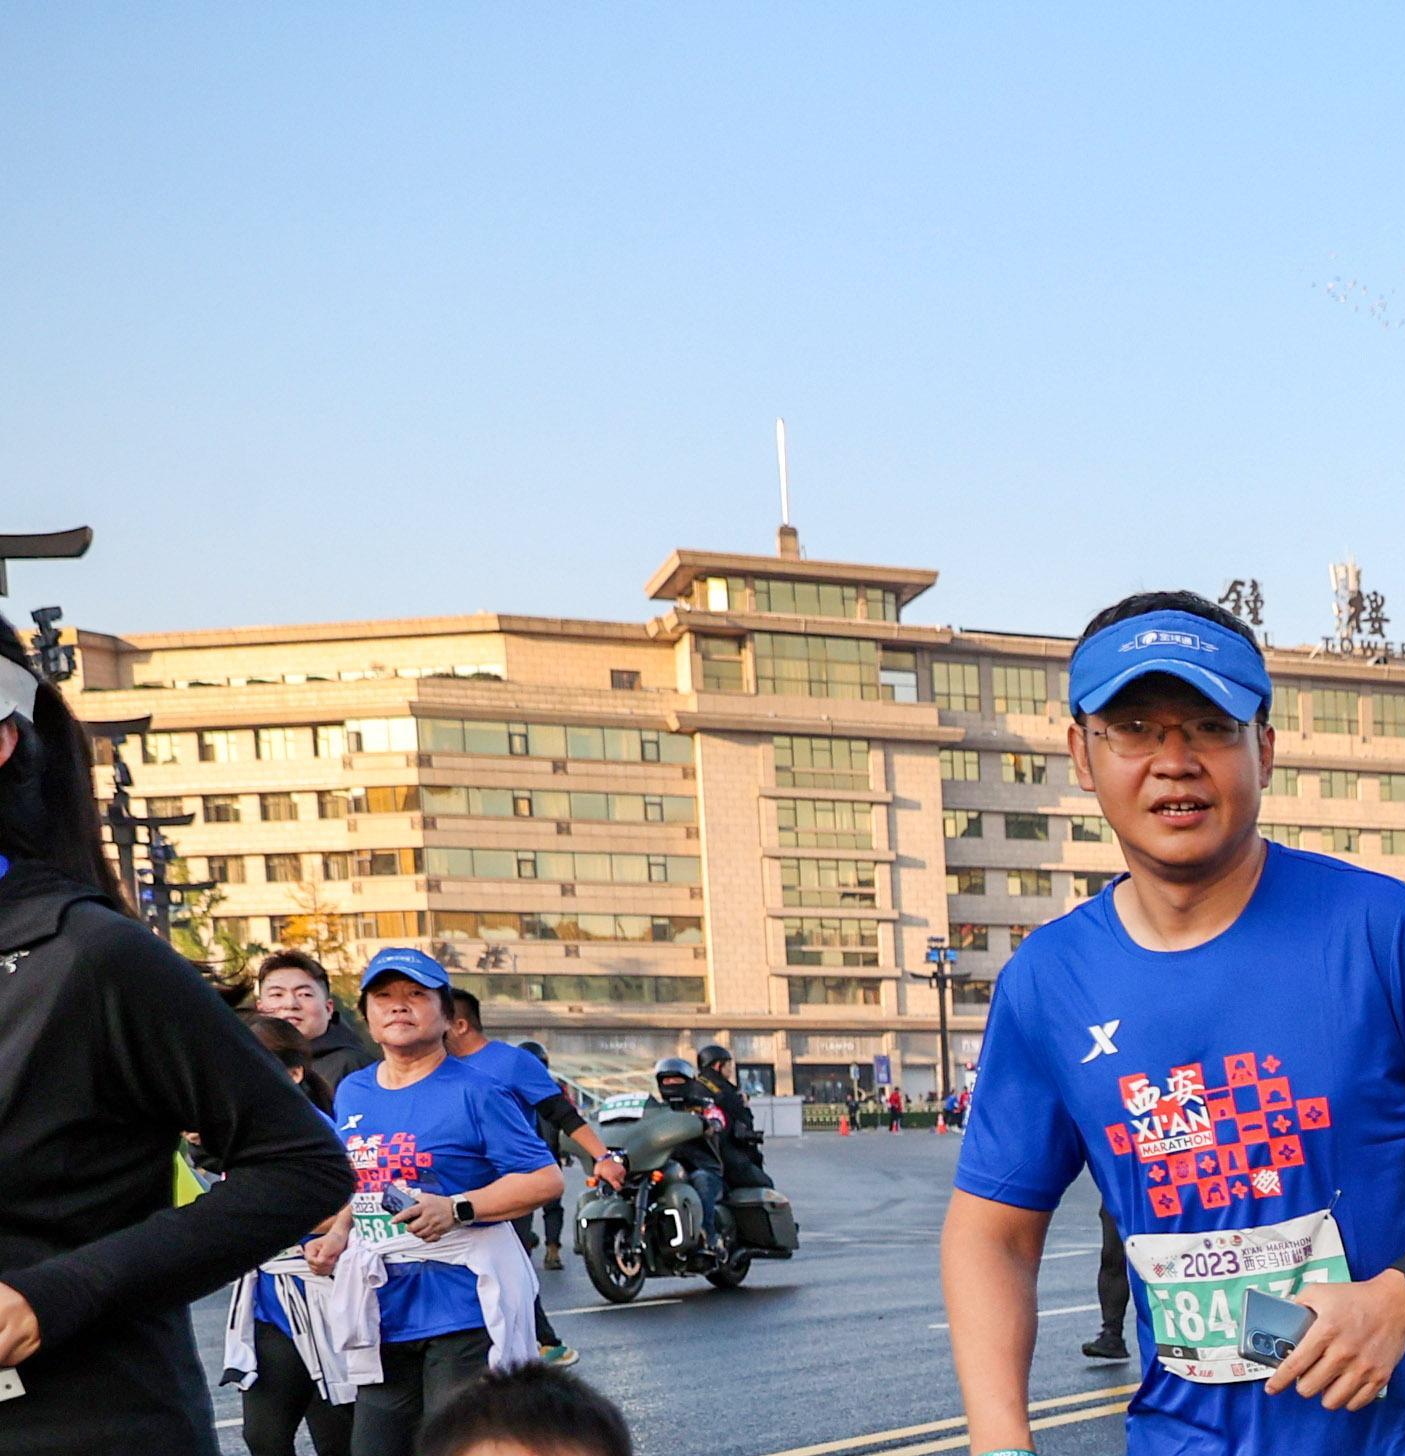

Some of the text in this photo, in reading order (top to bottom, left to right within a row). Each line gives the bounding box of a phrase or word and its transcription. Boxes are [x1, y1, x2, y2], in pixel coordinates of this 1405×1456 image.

[1126, 1068, 1205, 1117] 西安
[1130, 1104, 1212, 1143] XI'AN
[1141, 1132, 1213, 1157] MARATHON
[1181, 1250, 1241, 1278] 2023
[1266, 1236, 1313, 1252] MARATHON
